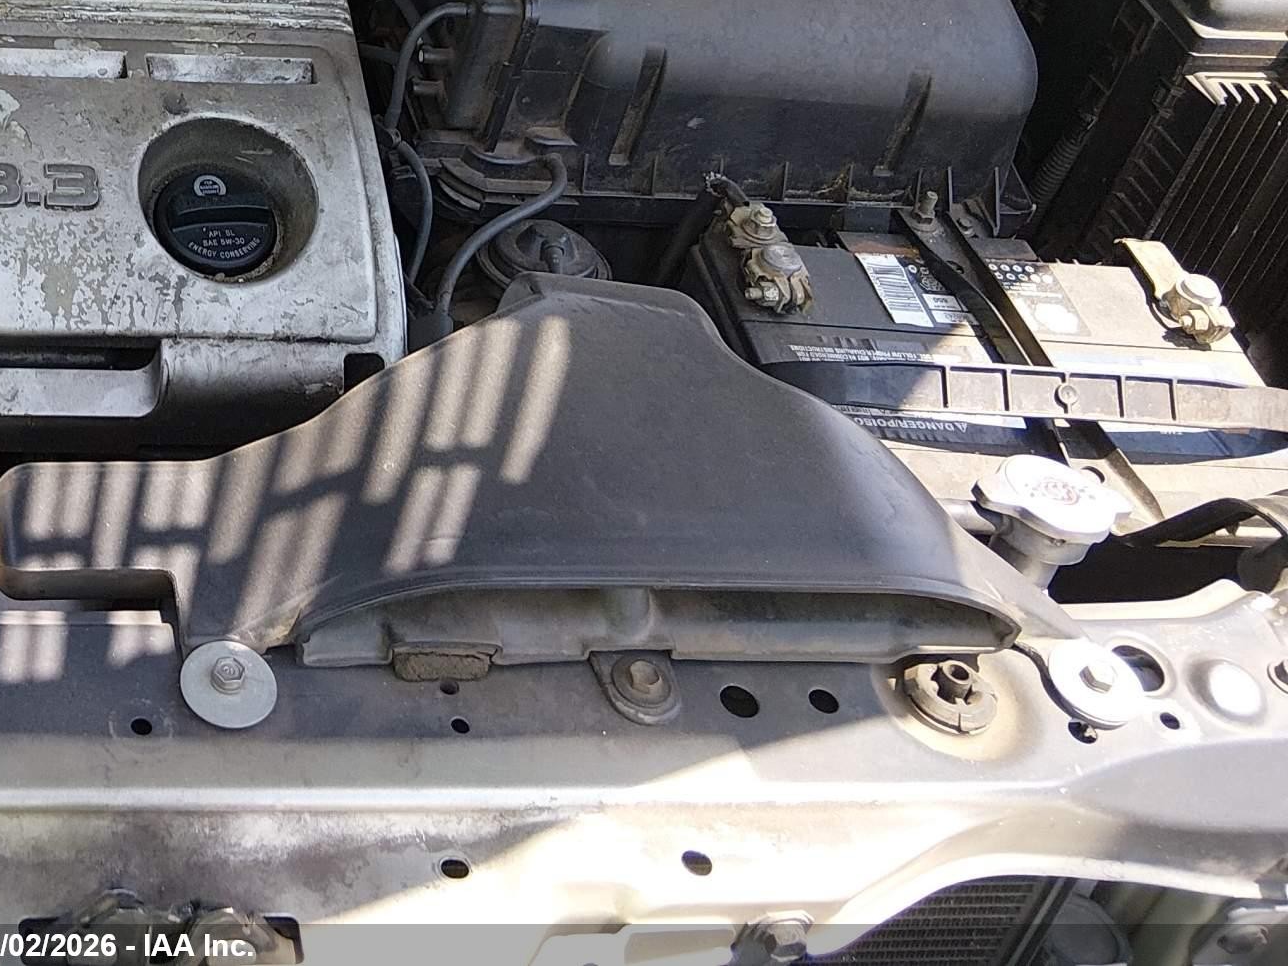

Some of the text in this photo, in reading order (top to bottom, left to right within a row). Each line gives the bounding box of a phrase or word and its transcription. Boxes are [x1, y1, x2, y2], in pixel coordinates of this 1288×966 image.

[209, 230, 221, 238] API
[188, 237, 261, 259] ENERGY CONSERVING
[202, 237, 245, 247] SAE 5W-30
[854, 417, 955, 433] DANGER/POISO
